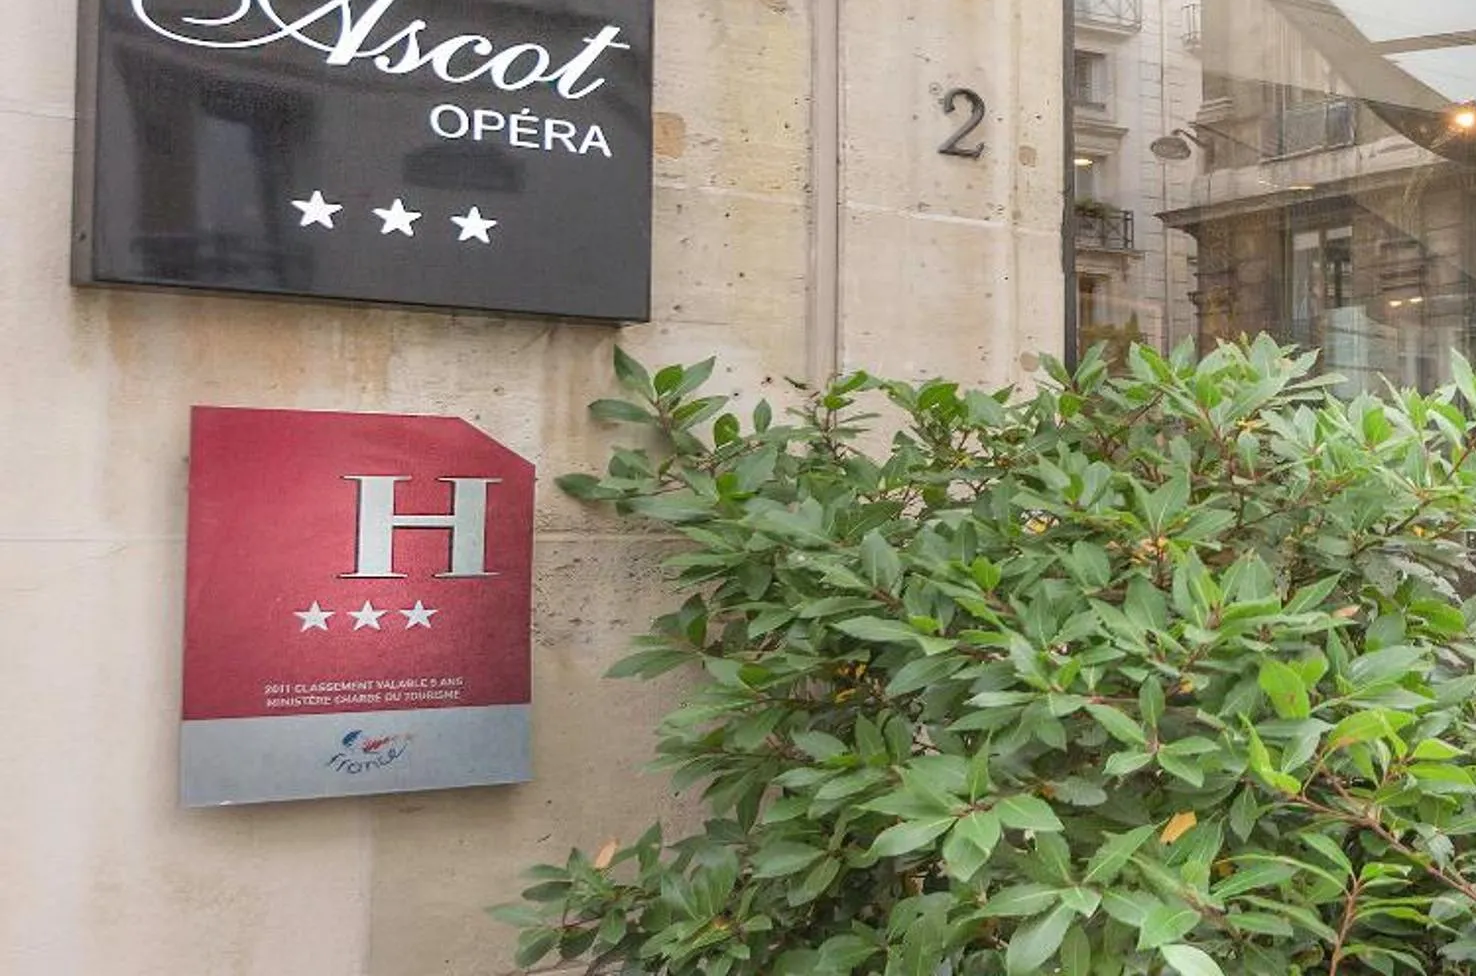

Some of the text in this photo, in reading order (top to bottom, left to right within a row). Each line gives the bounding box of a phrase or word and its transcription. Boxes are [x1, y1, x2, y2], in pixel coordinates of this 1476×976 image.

[429, 103, 612, 157] OPÉRA
[938, 87, 985, 157] 2
[339, 474, 504, 580] H
